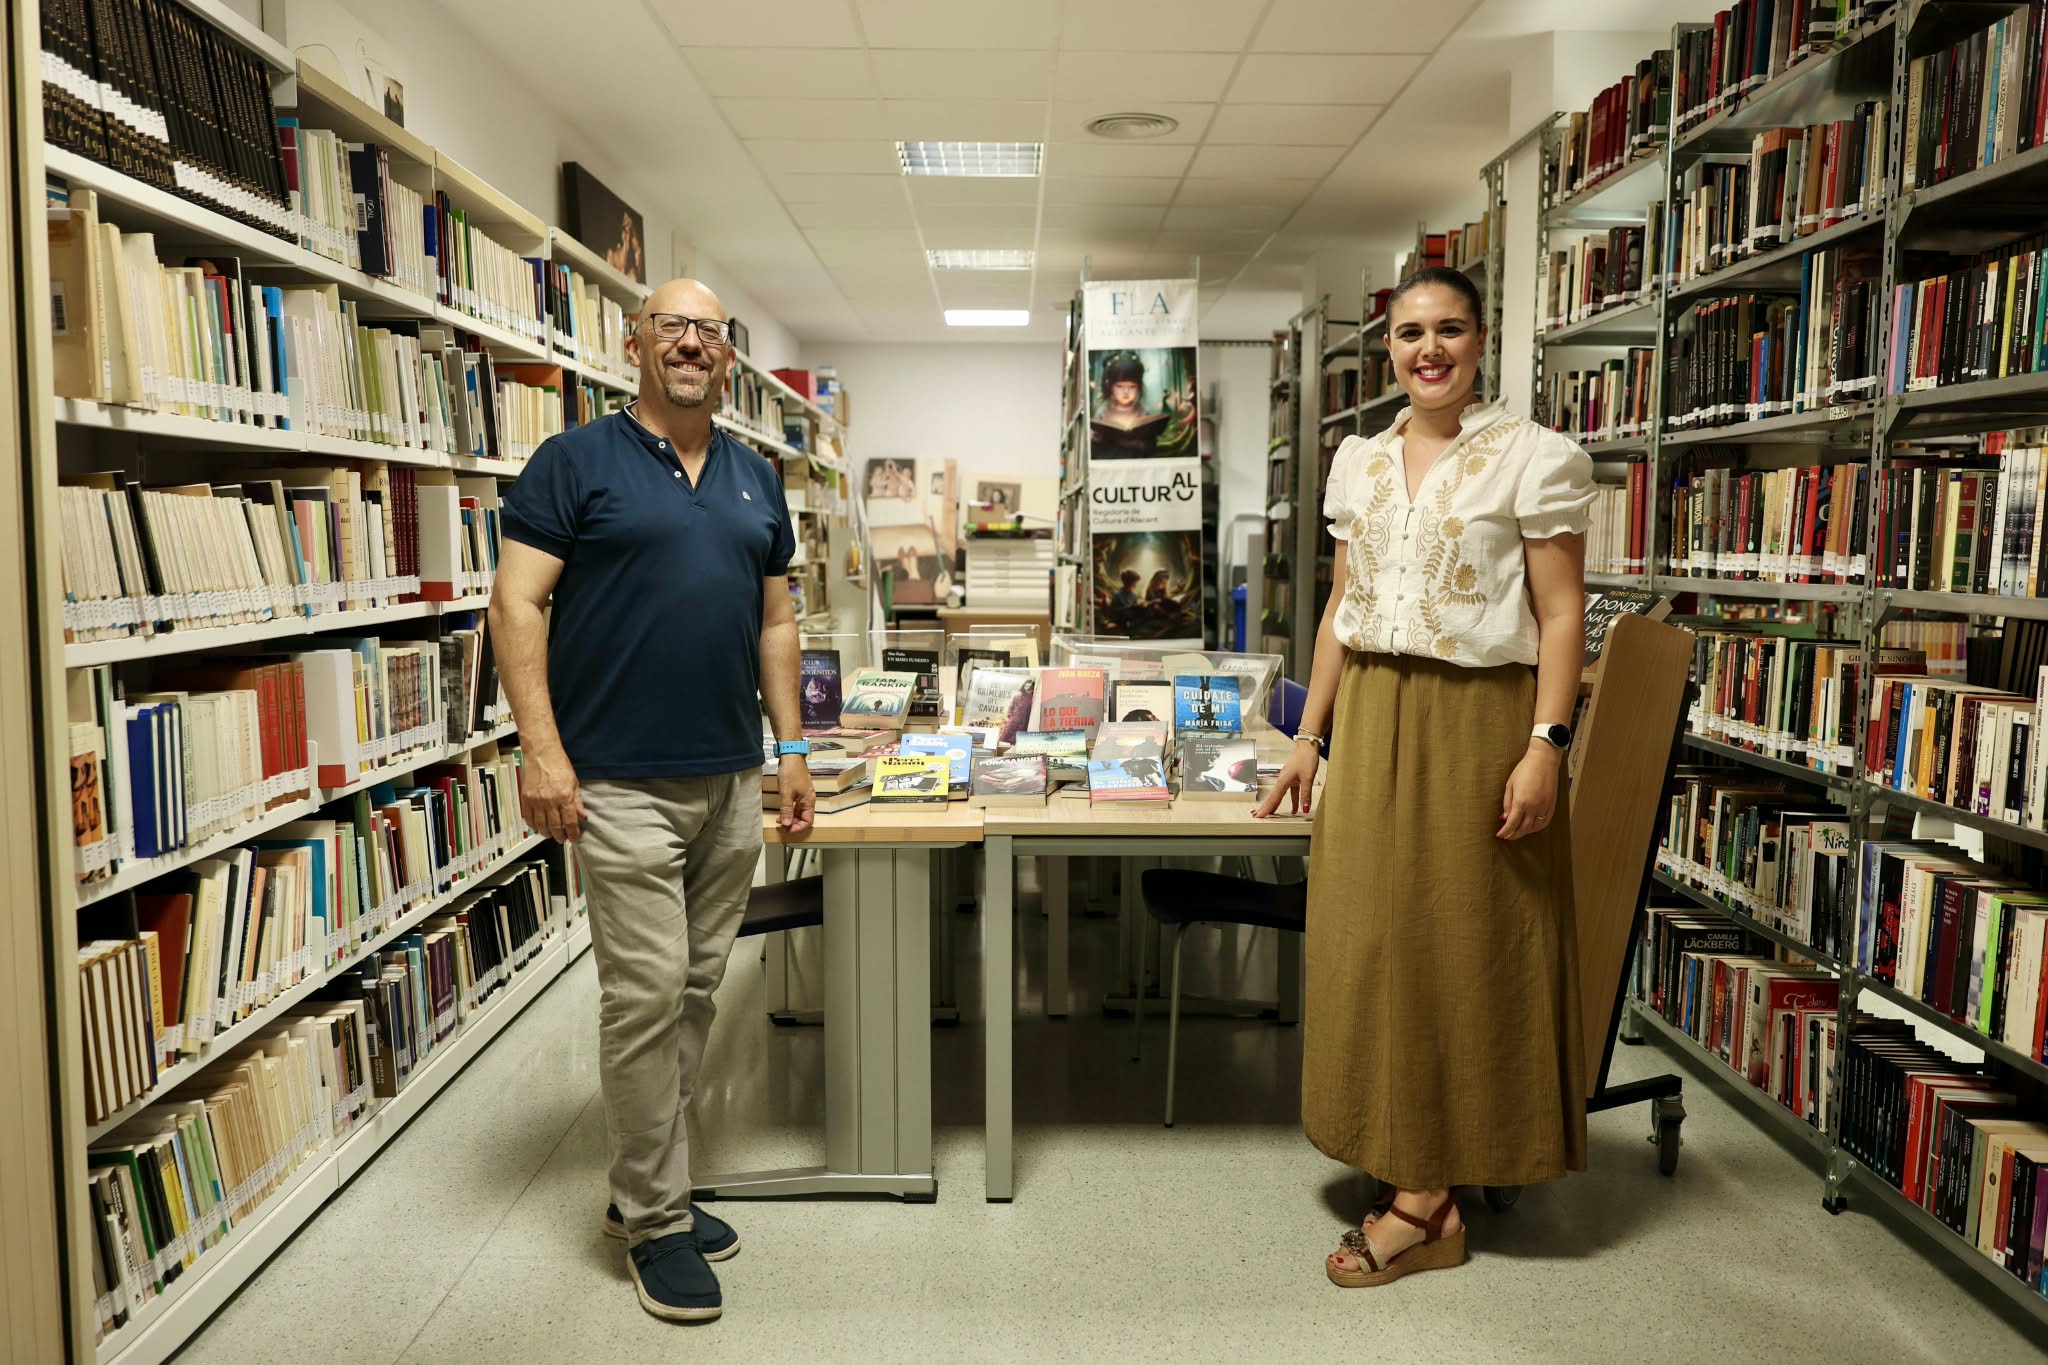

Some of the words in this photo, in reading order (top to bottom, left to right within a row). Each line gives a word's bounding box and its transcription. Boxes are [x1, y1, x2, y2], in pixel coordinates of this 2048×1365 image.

[1984, 482, 1994, 507] ECO
[1693, 492, 1704, 525] INSOMNIA
[1595, 599, 1644, 613] DONDE
[978, 705, 1004, 715] CAVIAR
[1043, 707, 1056, 718] LO
[1059, 706, 1079, 717] QUE
[1191, 703, 1206, 713] DE
[1043, 718, 1056, 728] LA
[1060, 717, 1095, 727] TIERRA
[1707, 933, 1739, 941] CAMILLA
[1684, 937, 1740, 950] LÄCKBERG
